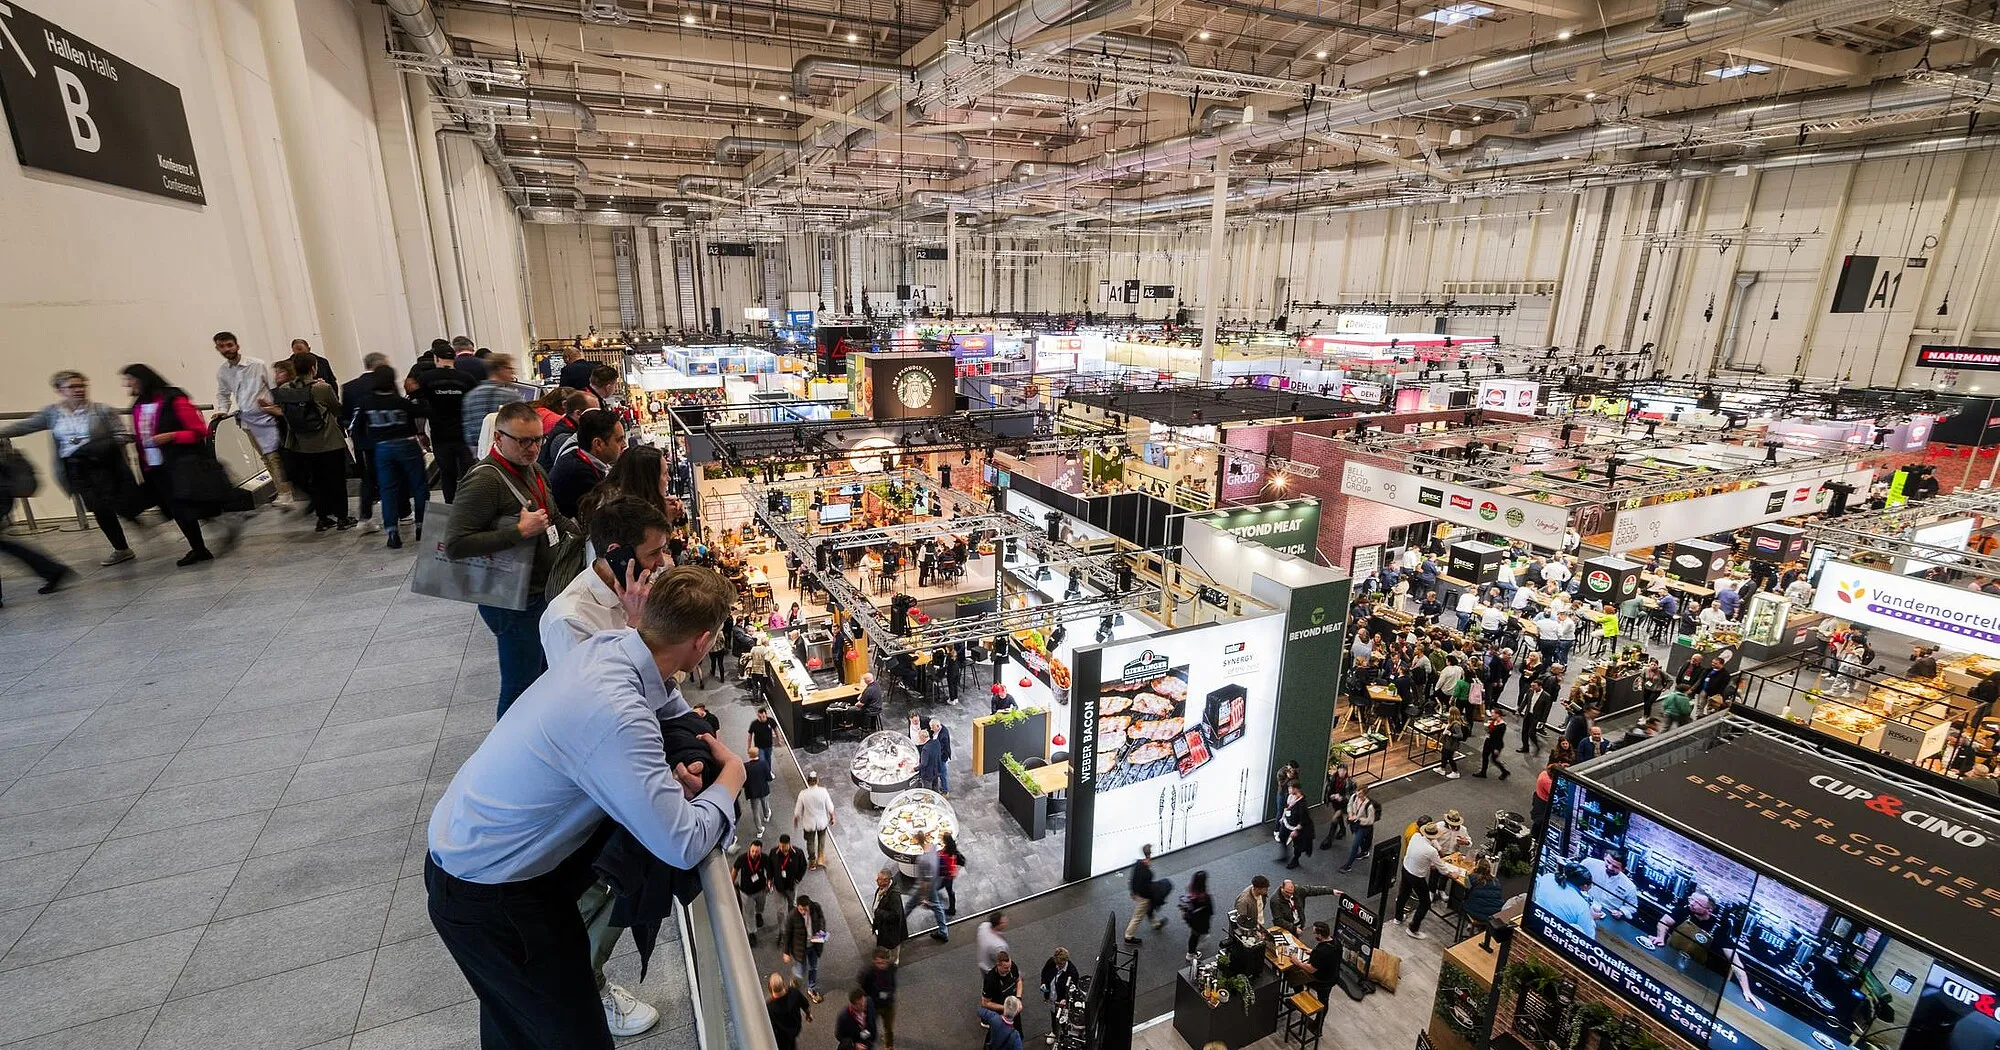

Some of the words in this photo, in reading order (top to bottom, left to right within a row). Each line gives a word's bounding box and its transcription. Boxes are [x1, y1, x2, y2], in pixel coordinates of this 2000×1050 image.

[44, 28, 88, 68] Hallen
[88, 50, 118, 82] Halls
[54, 65, 101, 153] B
[157, 154, 189, 176] Konferenz
[163, 175, 198, 196] Conference
[708, 247, 719, 255] A2
[917, 251, 927, 259] A2
[912, 288, 927, 300] A1
[1109, 286, 1122, 301] A1
[1144, 290, 1155, 298] A2
[1869, 270, 1902, 309] A1
[1227, 473, 1260, 485] GROUP
[1347, 474, 1368, 485] FOOD
[1348, 466, 1364, 477] BELL
[1346, 481, 1372, 494] GROUP
[1273, 518, 1304, 534] MEAT
[1617, 524, 1636, 536] FOOD
[1619, 517, 1635, 527] BELL
[1615, 534, 1639, 546] GROUP
[1289, 627, 1321, 641] BEYOND
[1322, 621, 1343, 634] MEAT
[1875, 606, 1994, 641] PROFESSIONAL
[1223, 655, 1253, 667] SYNERGY
[1084, 701, 1095, 735] BACON
[1081, 736, 1094, 784] WEBER
[1686, 774, 1803, 831] BETTER
[1809, 774, 1986, 848] CUP&CINO
[1716, 774, 1836, 829] BETTER
[1849, 832, 2000, 901] COFFEE
[1534, 908, 1643, 983] Siebträger-Qualität
[1644, 978, 1661, 994] im
[1663, 990, 1738, 1044] SB-Bereich
[1543, 925, 1620, 983] BaristaONE
[1624, 977, 1666, 1013] Touch
